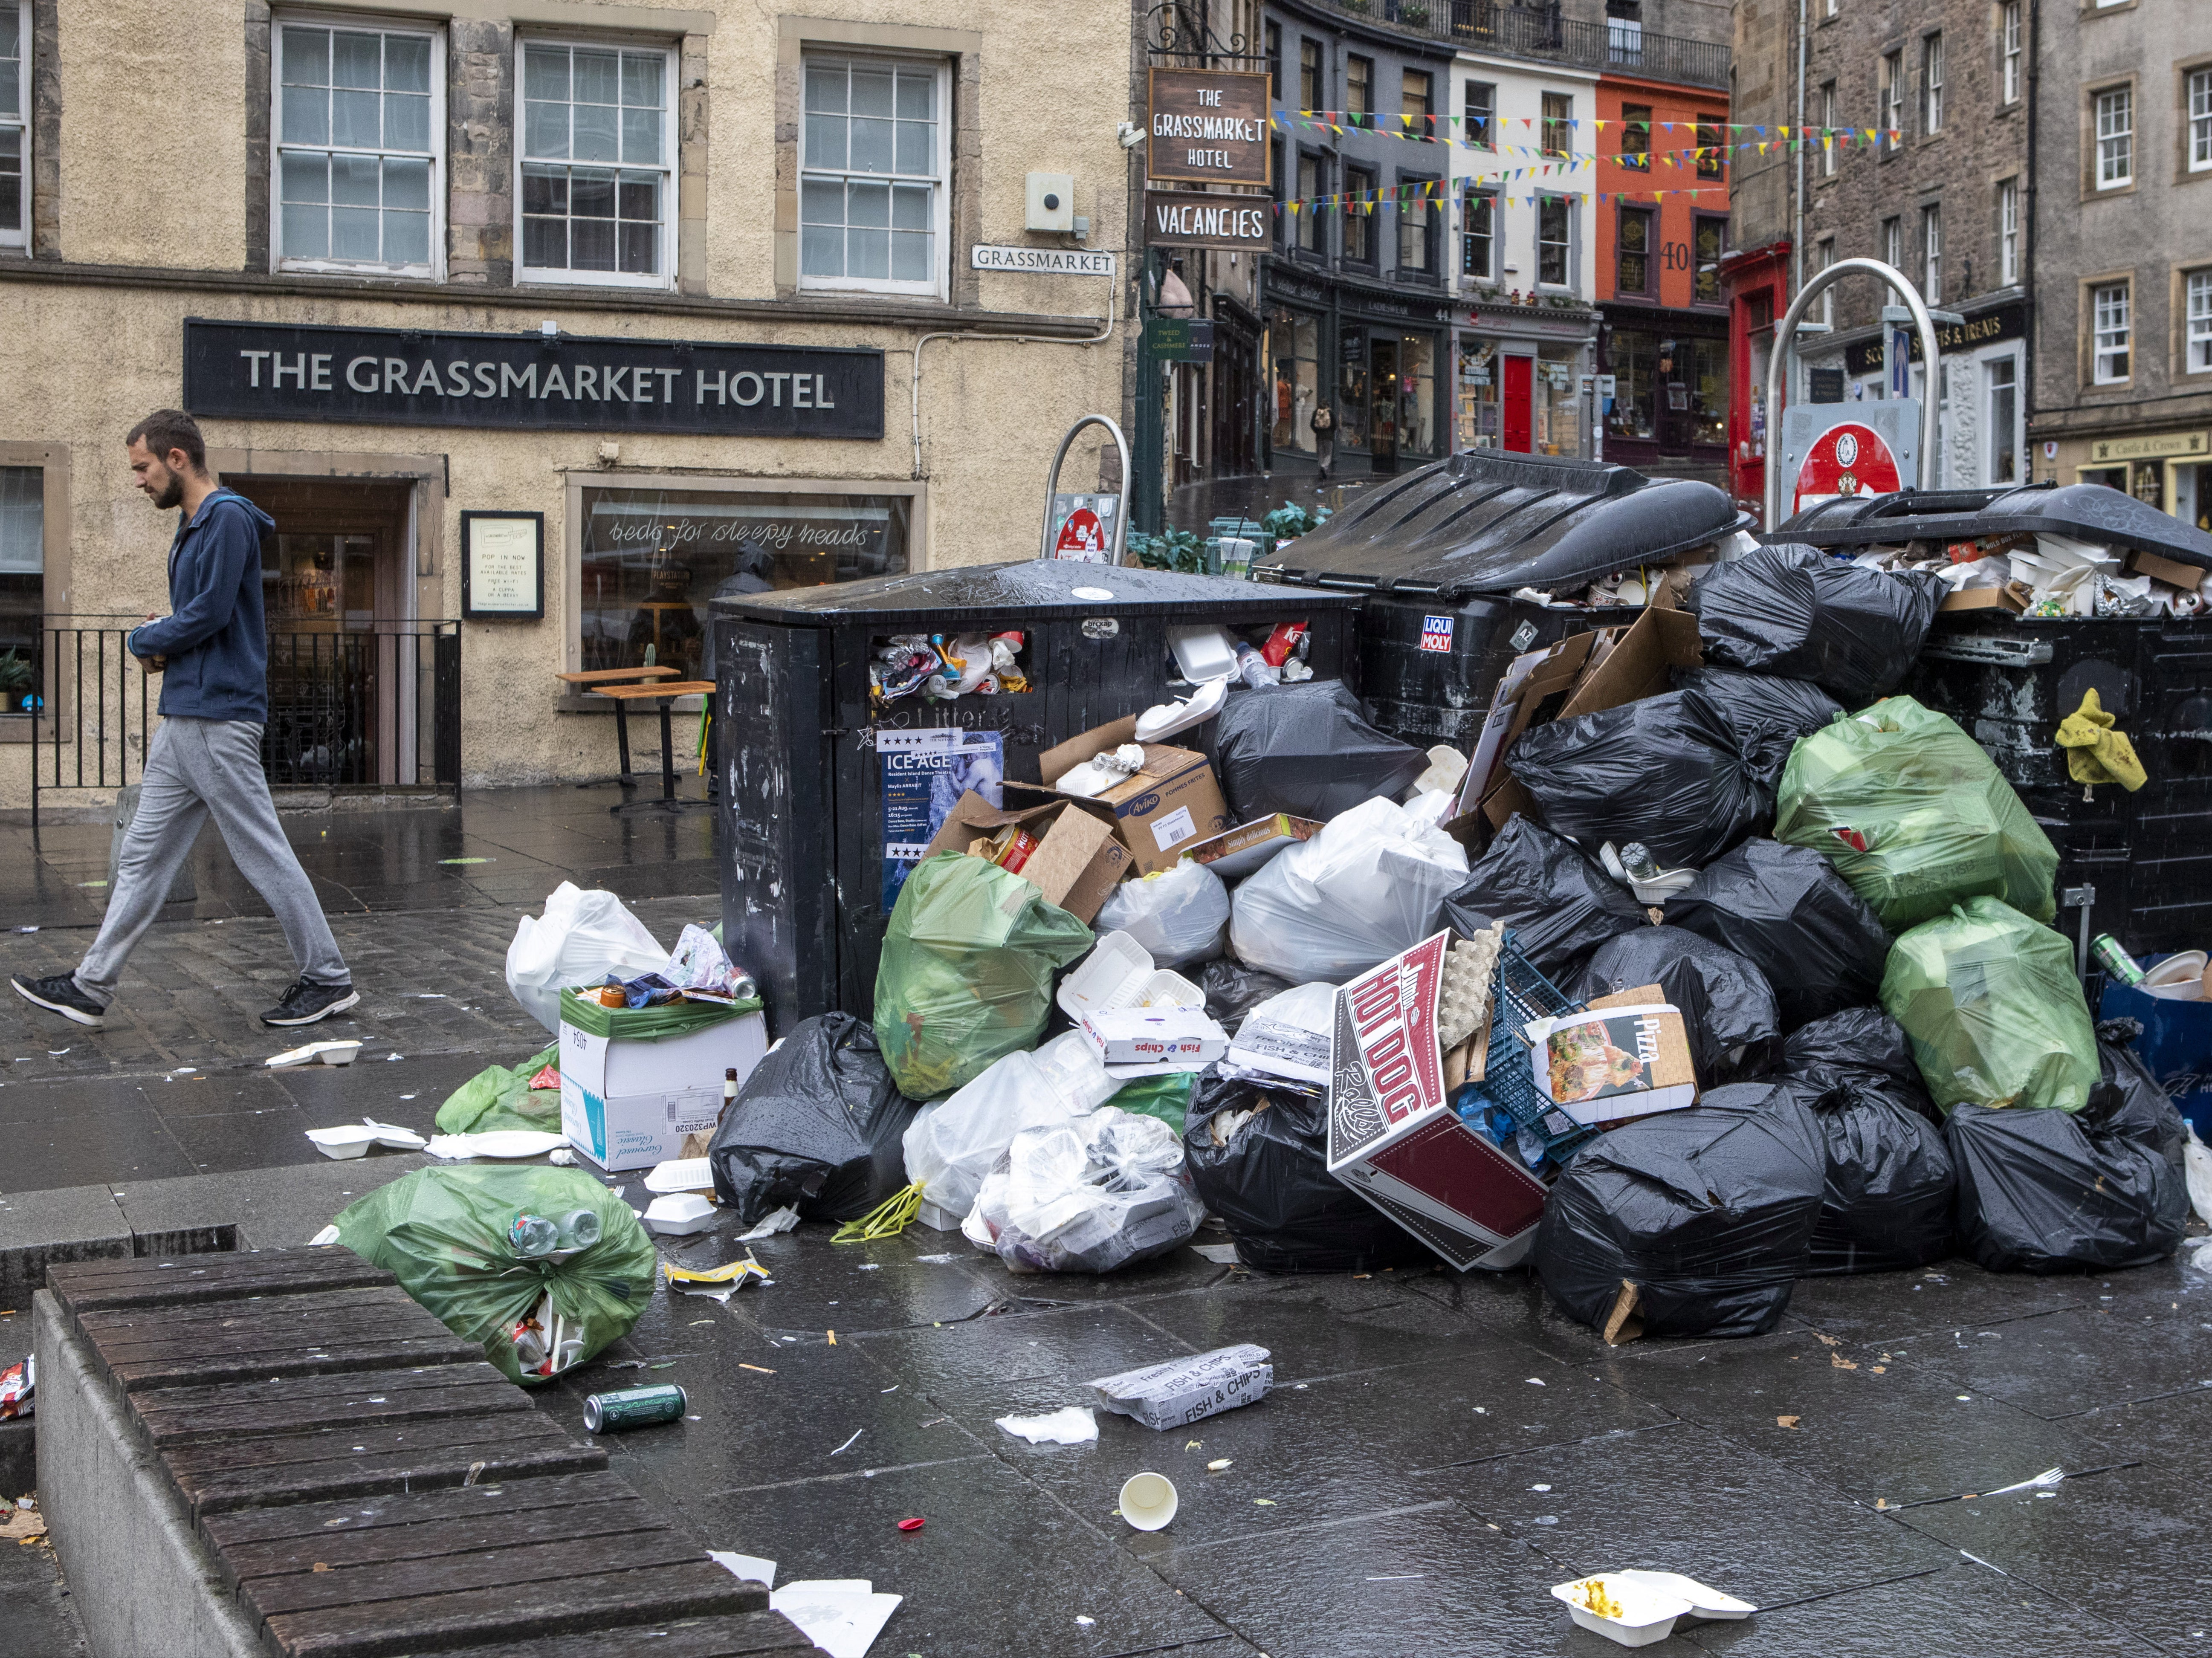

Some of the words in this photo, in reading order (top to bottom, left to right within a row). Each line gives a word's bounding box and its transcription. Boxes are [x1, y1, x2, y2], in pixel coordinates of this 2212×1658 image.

[1197, 90, 1223, 107] THE
[1154, 113, 1265, 141] GRASSMARKET
[1188, 149, 1233, 168] HOTEL
[1157, 205, 1263, 238] VACANCIES
[978, 250, 1110, 272] GRASSMARKET
[1965, 317, 2001, 341] TREATS
[240, 350, 333, 391] THE
[346, 356, 682, 403] GRASSMARKET
[697, 370, 834, 409] HOTEL
[2116, 442, 2141, 454] Castle
[2144, 441, 2150, 452] &
[2153, 440, 2181, 451] Crown
[610, 518, 663, 541] beds
[667, 518, 706, 550] for
[711, 520, 793, 549] sleepy
[799, 523, 869, 546] heads
[1986, 540, 2000, 550] HOLD
[2001, 535, 2012, 544] BOX
[1425, 618, 1451, 634] LIQUI
[1519, 628, 1532, 642] AZ
[1422, 634, 1450, 650] MOLY
[888, 755, 913, 770] ICE
[917, 755, 952, 768] AGE
[1165, 782, 1187, 797] POMMES
[1187, 773, 1205, 785] FRITES
[1133, 796, 1158, 815] Aviko
[1167, 815, 1184, 826] Steakhouse
[1228, 835, 1245, 848] Simply
[1246, 827, 1270, 841] delicious
[1401, 962, 1424, 1011] Jumbo
[1349, 963, 1402, 1039] HOT
[1083, 1019, 1092, 1034] Chips
[573, 1029, 587, 1050] 4054
[1135, 1043, 1164, 1053] Chips
[1167, 1044, 1177, 1053] &
[1257, 1044, 1285, 1052] FISH
[1364, 1025, 1421, 1126] DOG
[563, 1094, 577, 1116] Classic
[564, 1111, 582, 1136] Carousel
[675, 1122, 716, 1133] WP320320
[617, 1135, 653, 1146] Classic
[616, 1145, 662, 1159] Carousel
[1140, 1366, 1173, 1382] Freshly
[1164, 1374, 1192, 1391] FISH
[1199, 1354, 1231, 1372] CHIPS
[1185, 1396, 1213, 1422] FISH
[1215, 1390, 1225, 1404] &
[1227, 1369, 1260, 1395] CHIPS
